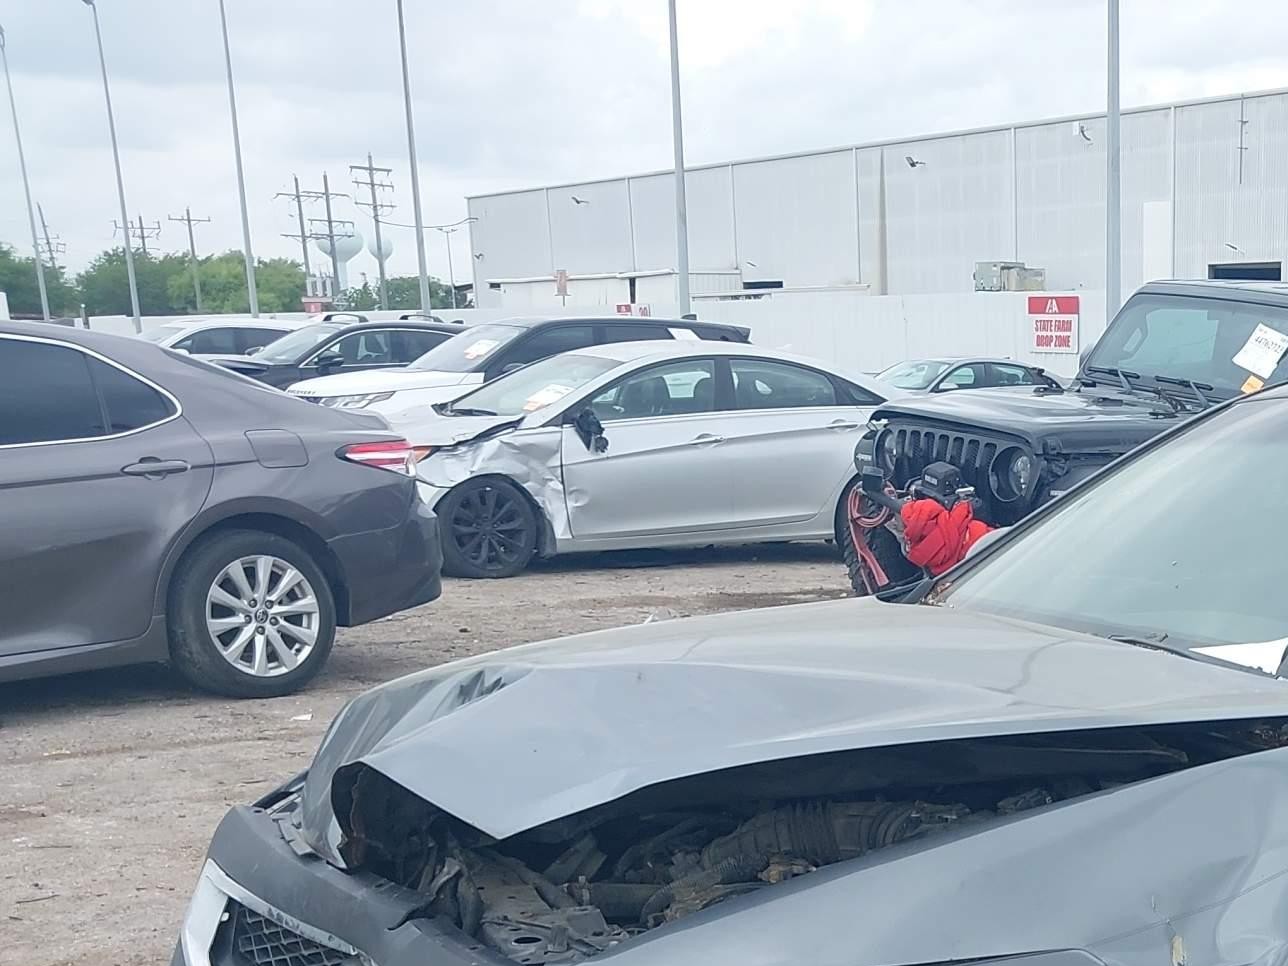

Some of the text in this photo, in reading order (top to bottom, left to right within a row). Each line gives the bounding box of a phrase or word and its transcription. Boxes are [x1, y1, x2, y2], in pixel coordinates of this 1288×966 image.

[1034, 319, 1073, 333] STATE FARM
[1035, 334, 1071, 348] DROP ZONE
